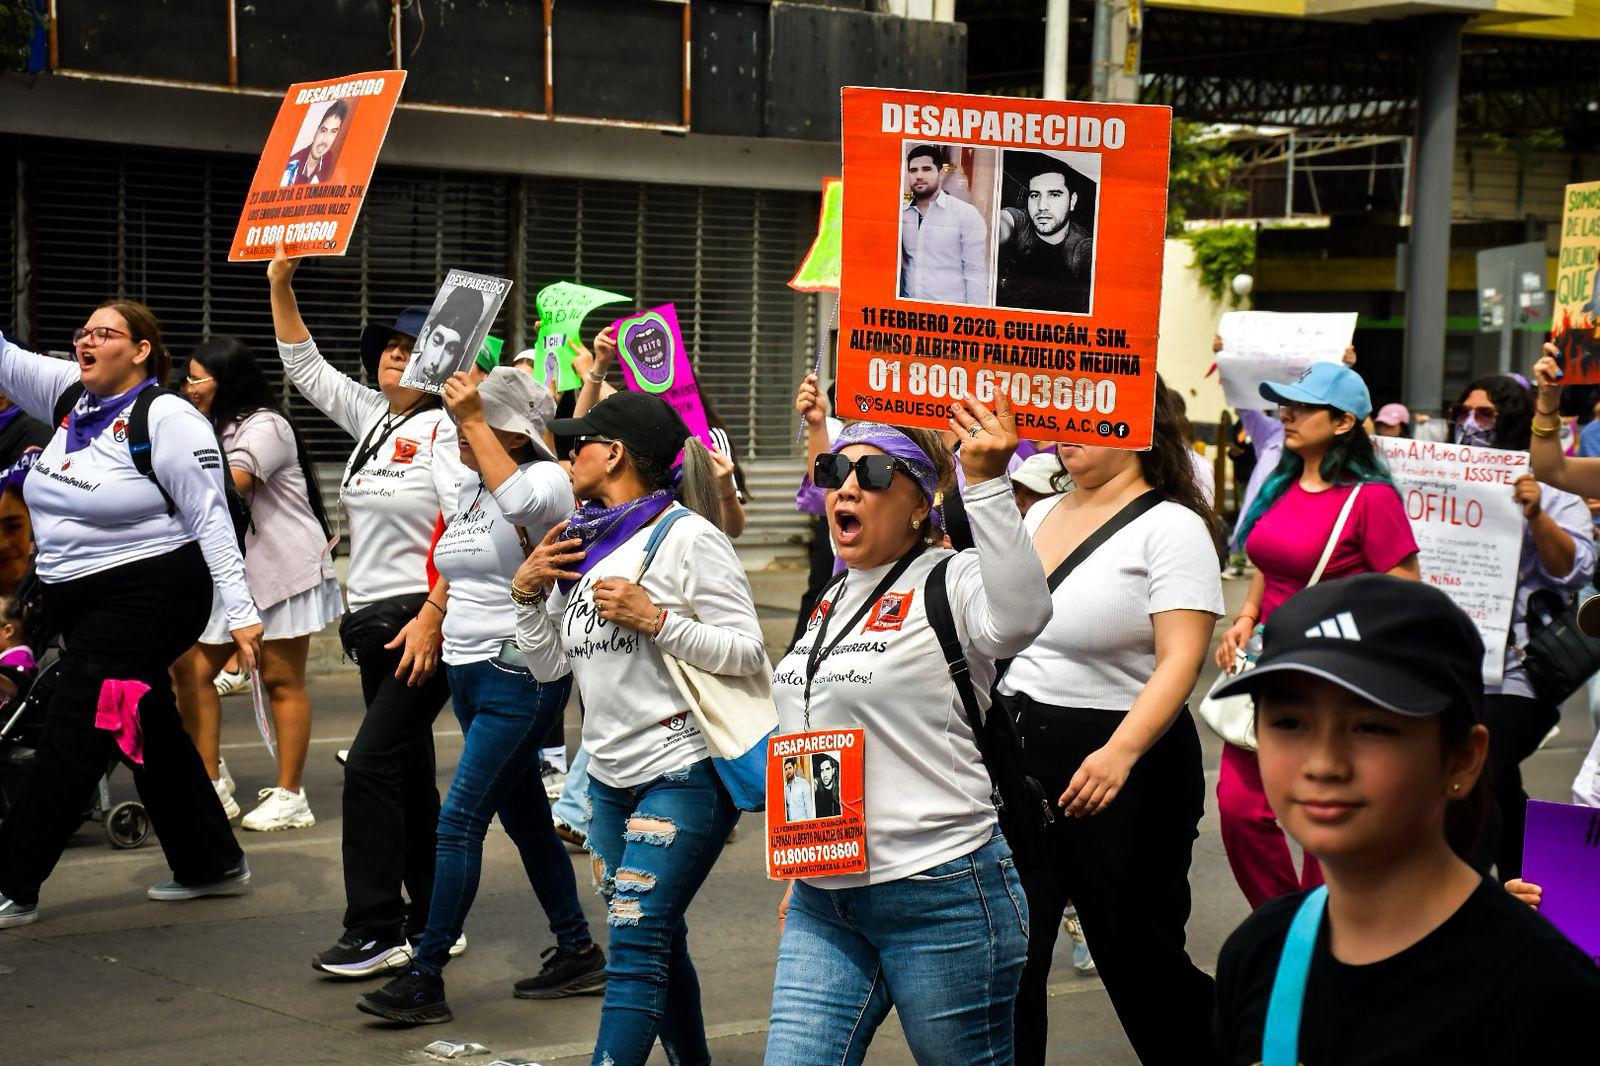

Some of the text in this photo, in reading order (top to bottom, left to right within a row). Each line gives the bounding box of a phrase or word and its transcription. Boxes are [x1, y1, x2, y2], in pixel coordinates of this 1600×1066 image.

[295, 77, 385, 105] DESAPARECIDO
[881, 102, 1126, 150] DESAPARECIDO
[295, 187, 303, 200] EL
[1567, 188, 1600, 212] SOMOS
[247, 208, 259, 221] LUIS
[259, 207, 282, 220] ENRIQUE
[327, 202, 351, 215] VALDEZ
[246, 220, 338, 247] 01 800 6703600
[1566, 216, 1581, 237] DE
[1562, 245, 1597, 269] QUE NO
[446, 274, 505, 295] DESAPARECIDO
[861, 306, 1131, 350] 11 FEBRERO 2020, CULIACÁN, SIN.
[850, 329, 1141, 376] ALFONSO ALBERTO PALAZUELOS MEDINA
[868, 357, 1117, 415] 01 800 6703600
[874, 397, 955, 419] SABUESOS
[1065, 417, 1095, 433] A.C.
[1408, 441, 1419, 460] A
[1422, 443, 1456, 462] Mora
[1407, 489, 1484, 528] OFILO
[565, 626, 640, 660] ncontrarlos!
[832, 641, 888, 656] GUERRERAS
[812, 670, 873, 685] ncontrarlos!
[773, 733, 855, 757] DESAPARECIDO
[780, 822, 805, 833] FEBRERO
[793, 830, 814, 846] ALBERTO
[844, 825, 863, 840] MEDINA
[773, 841, 859, 866] 018006703600
